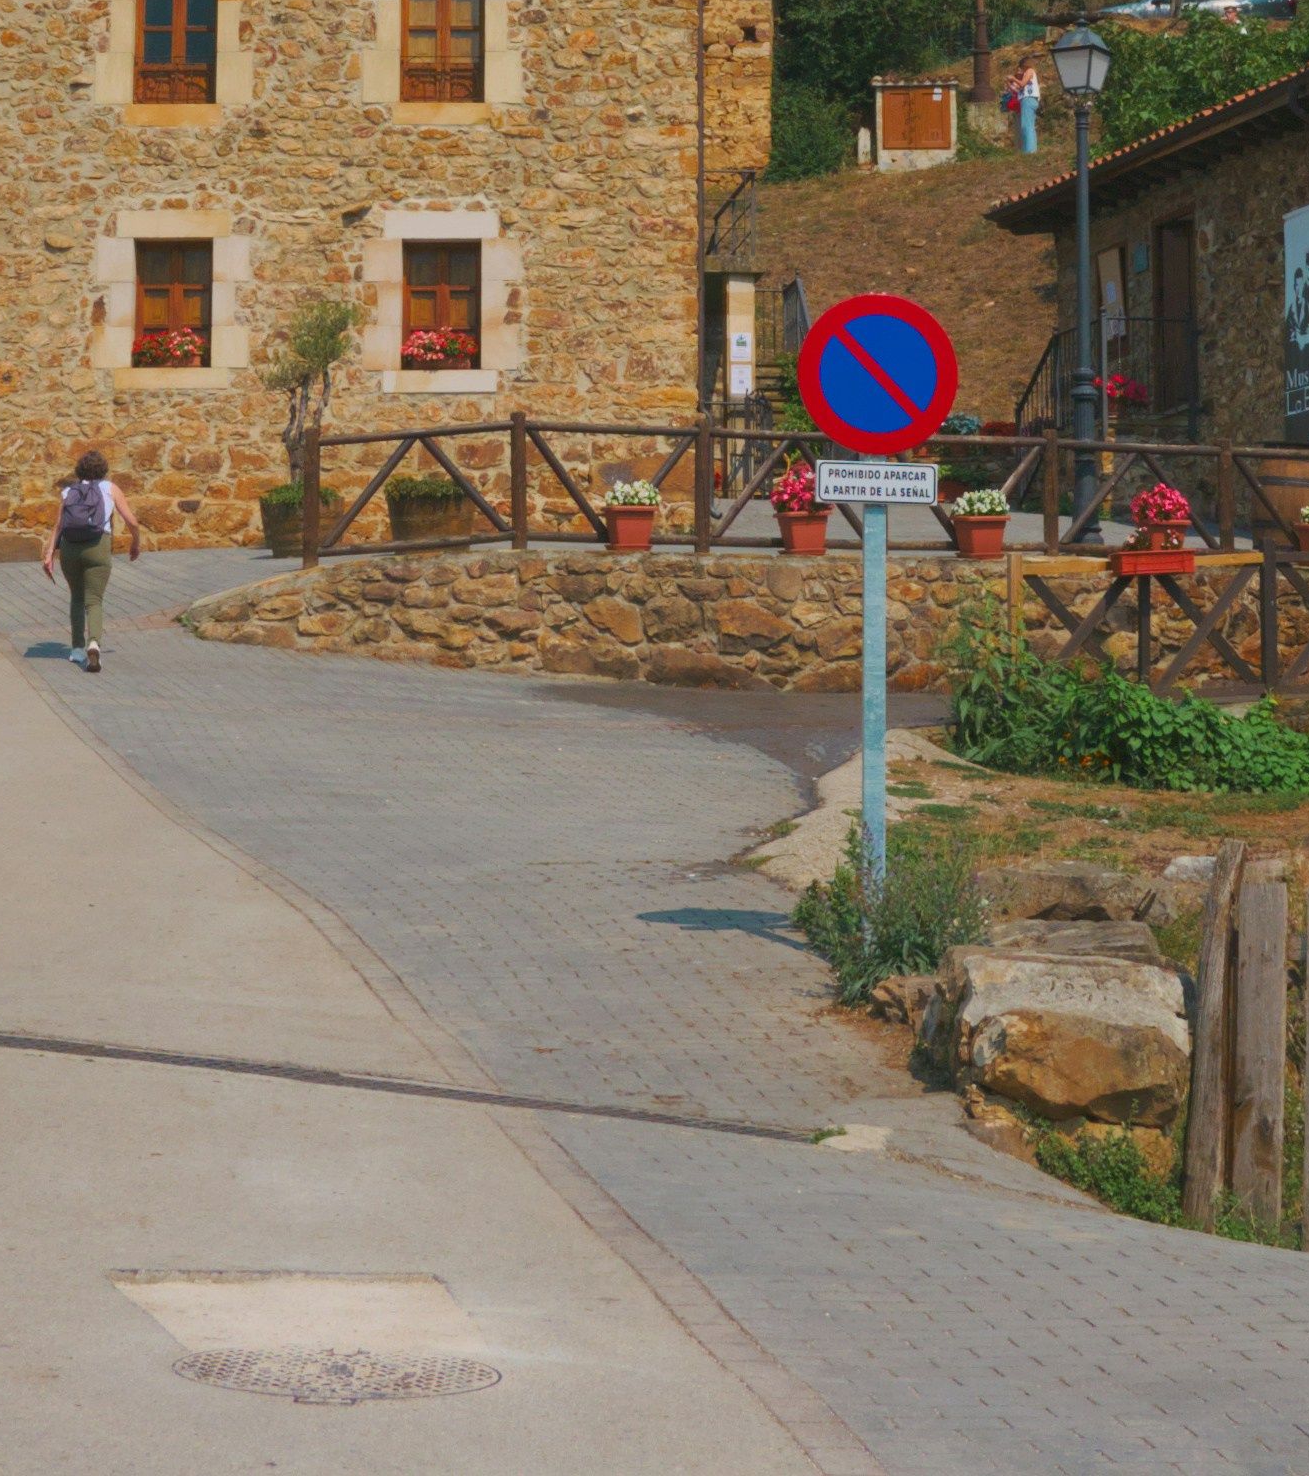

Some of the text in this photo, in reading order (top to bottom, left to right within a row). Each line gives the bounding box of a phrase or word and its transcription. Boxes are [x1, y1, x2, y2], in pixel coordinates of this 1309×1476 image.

[828, 468, 927, 481] PROHIBIDO APARCAR
[823, 485, 931, 498] A PARTIR DE LA SEÑAL
